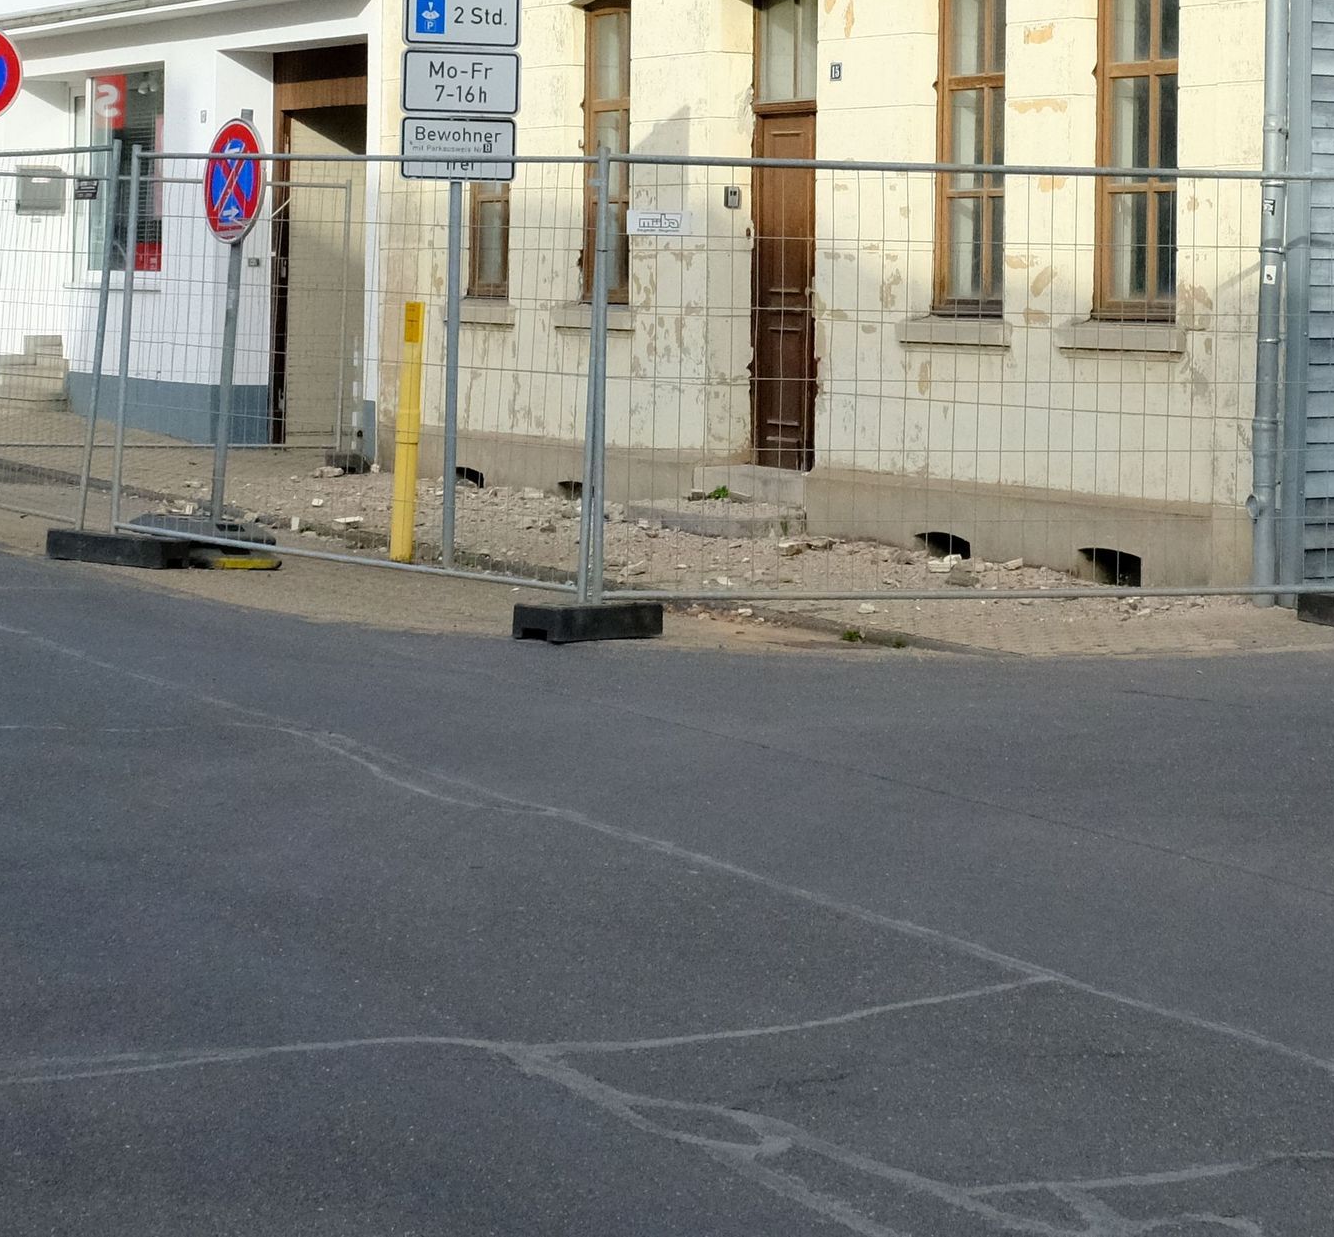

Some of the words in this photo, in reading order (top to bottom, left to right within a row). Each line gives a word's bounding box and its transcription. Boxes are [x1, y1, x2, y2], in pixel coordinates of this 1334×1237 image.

[453, 6, 464, 24] 2
[470, 6, 507, 26] Std.
[429, 60, 493, 80] Mo-Fr
[832, 65, 840, 79] 15
[415, 125, 503, 143] Bewohner
